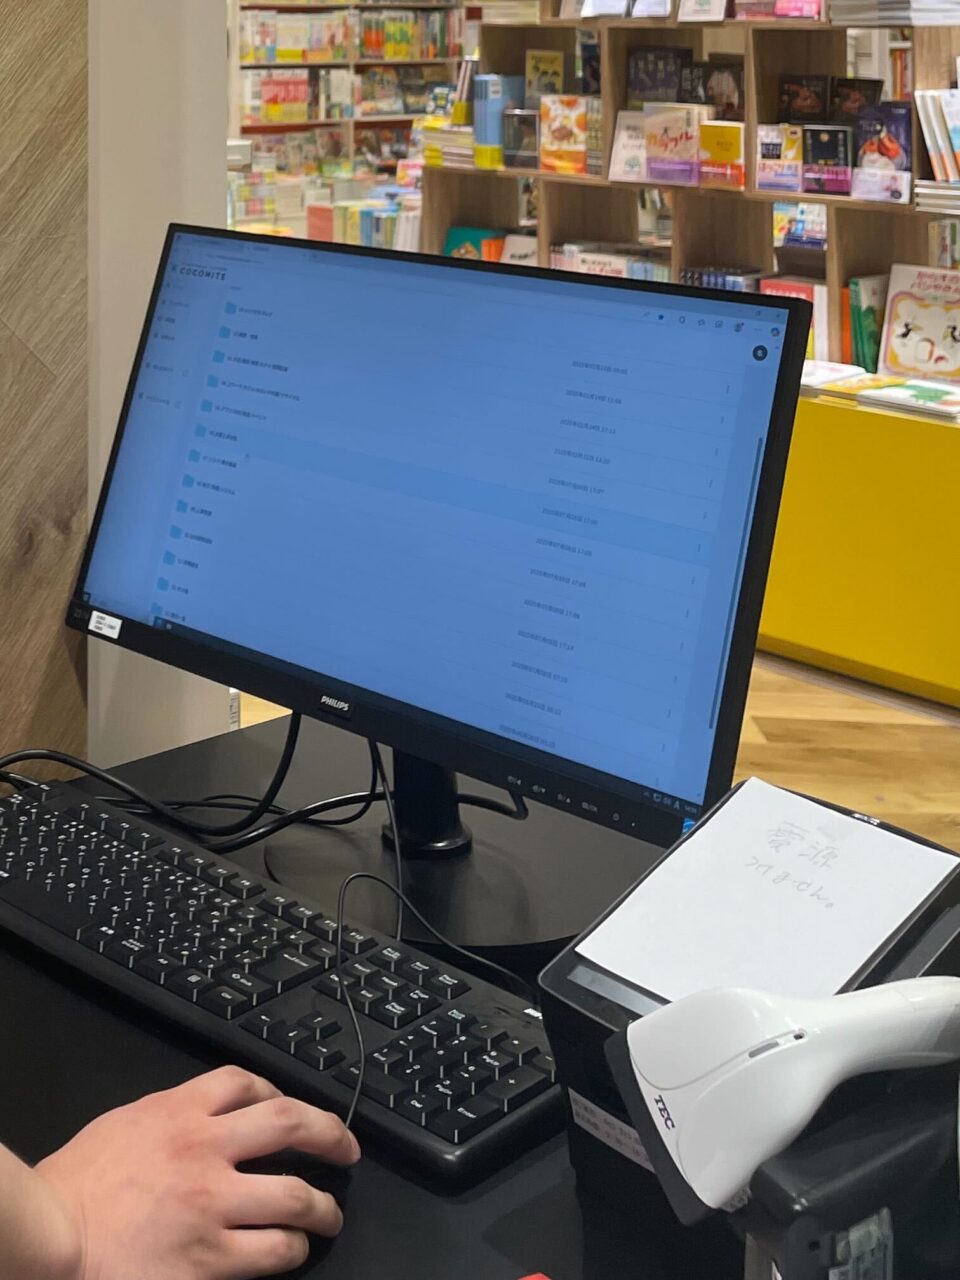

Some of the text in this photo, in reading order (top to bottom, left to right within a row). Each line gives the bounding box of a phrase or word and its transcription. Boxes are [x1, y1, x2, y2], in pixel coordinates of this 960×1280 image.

[179, 267, 227, 281] COCOMITE
[321, 695, 350, 711] PHILIPS
[653, 1094, 676, 1130] TEC
